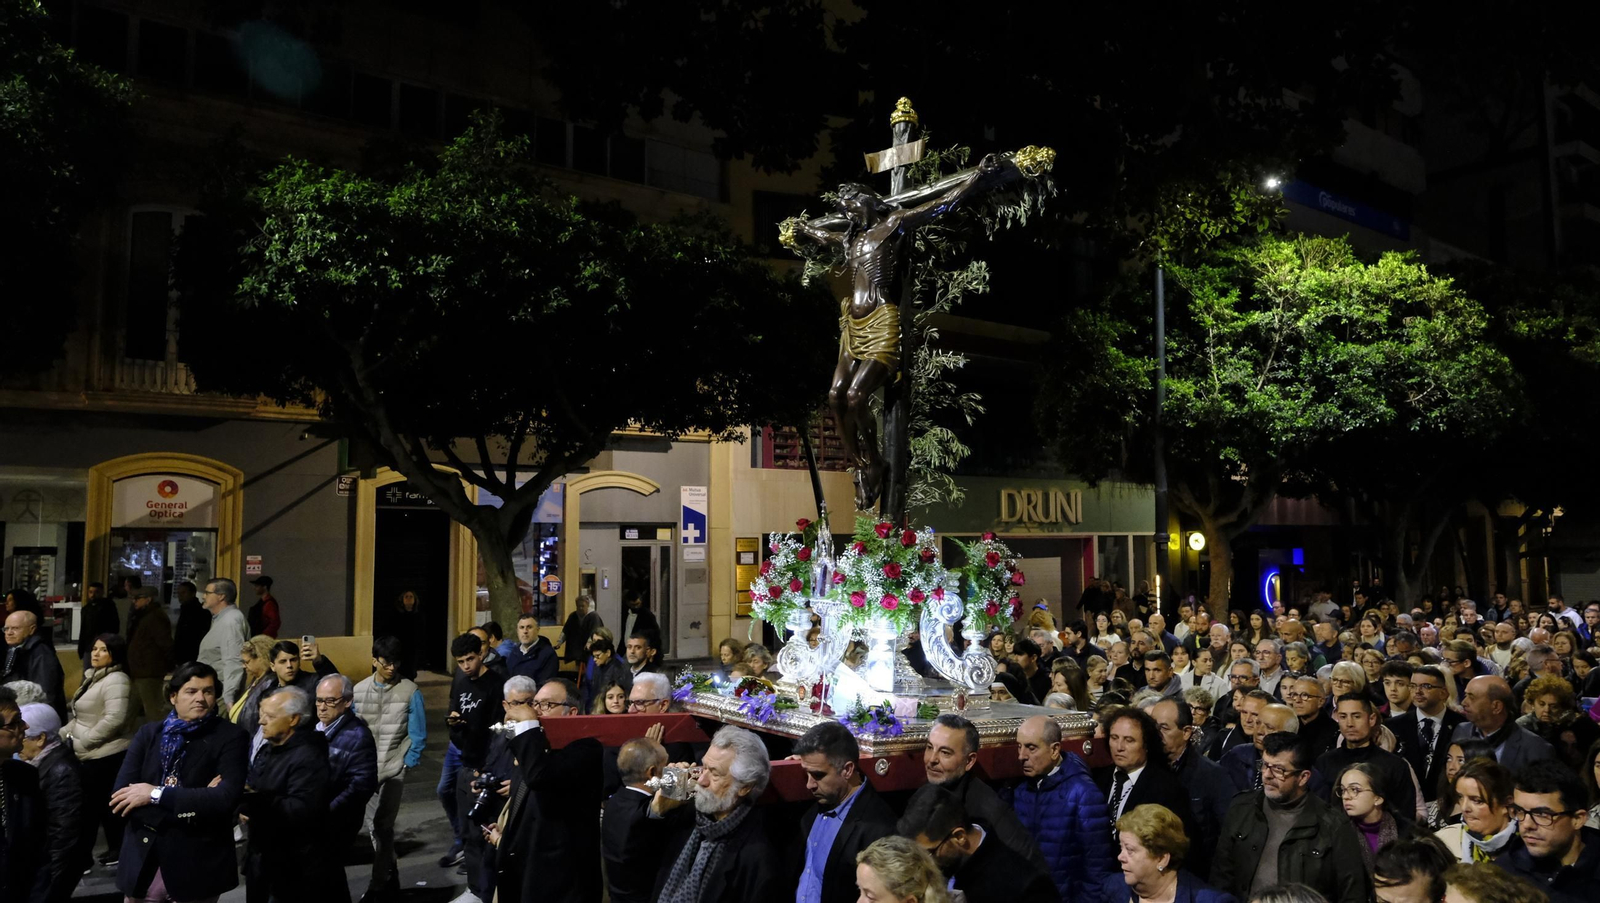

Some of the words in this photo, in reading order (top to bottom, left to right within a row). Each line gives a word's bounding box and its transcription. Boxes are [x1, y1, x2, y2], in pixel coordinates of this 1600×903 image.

[146, 500, 188, 509] General
[1001, 488, 1083, 524] DRUNI
[149, 509, 184, 520] Optica
